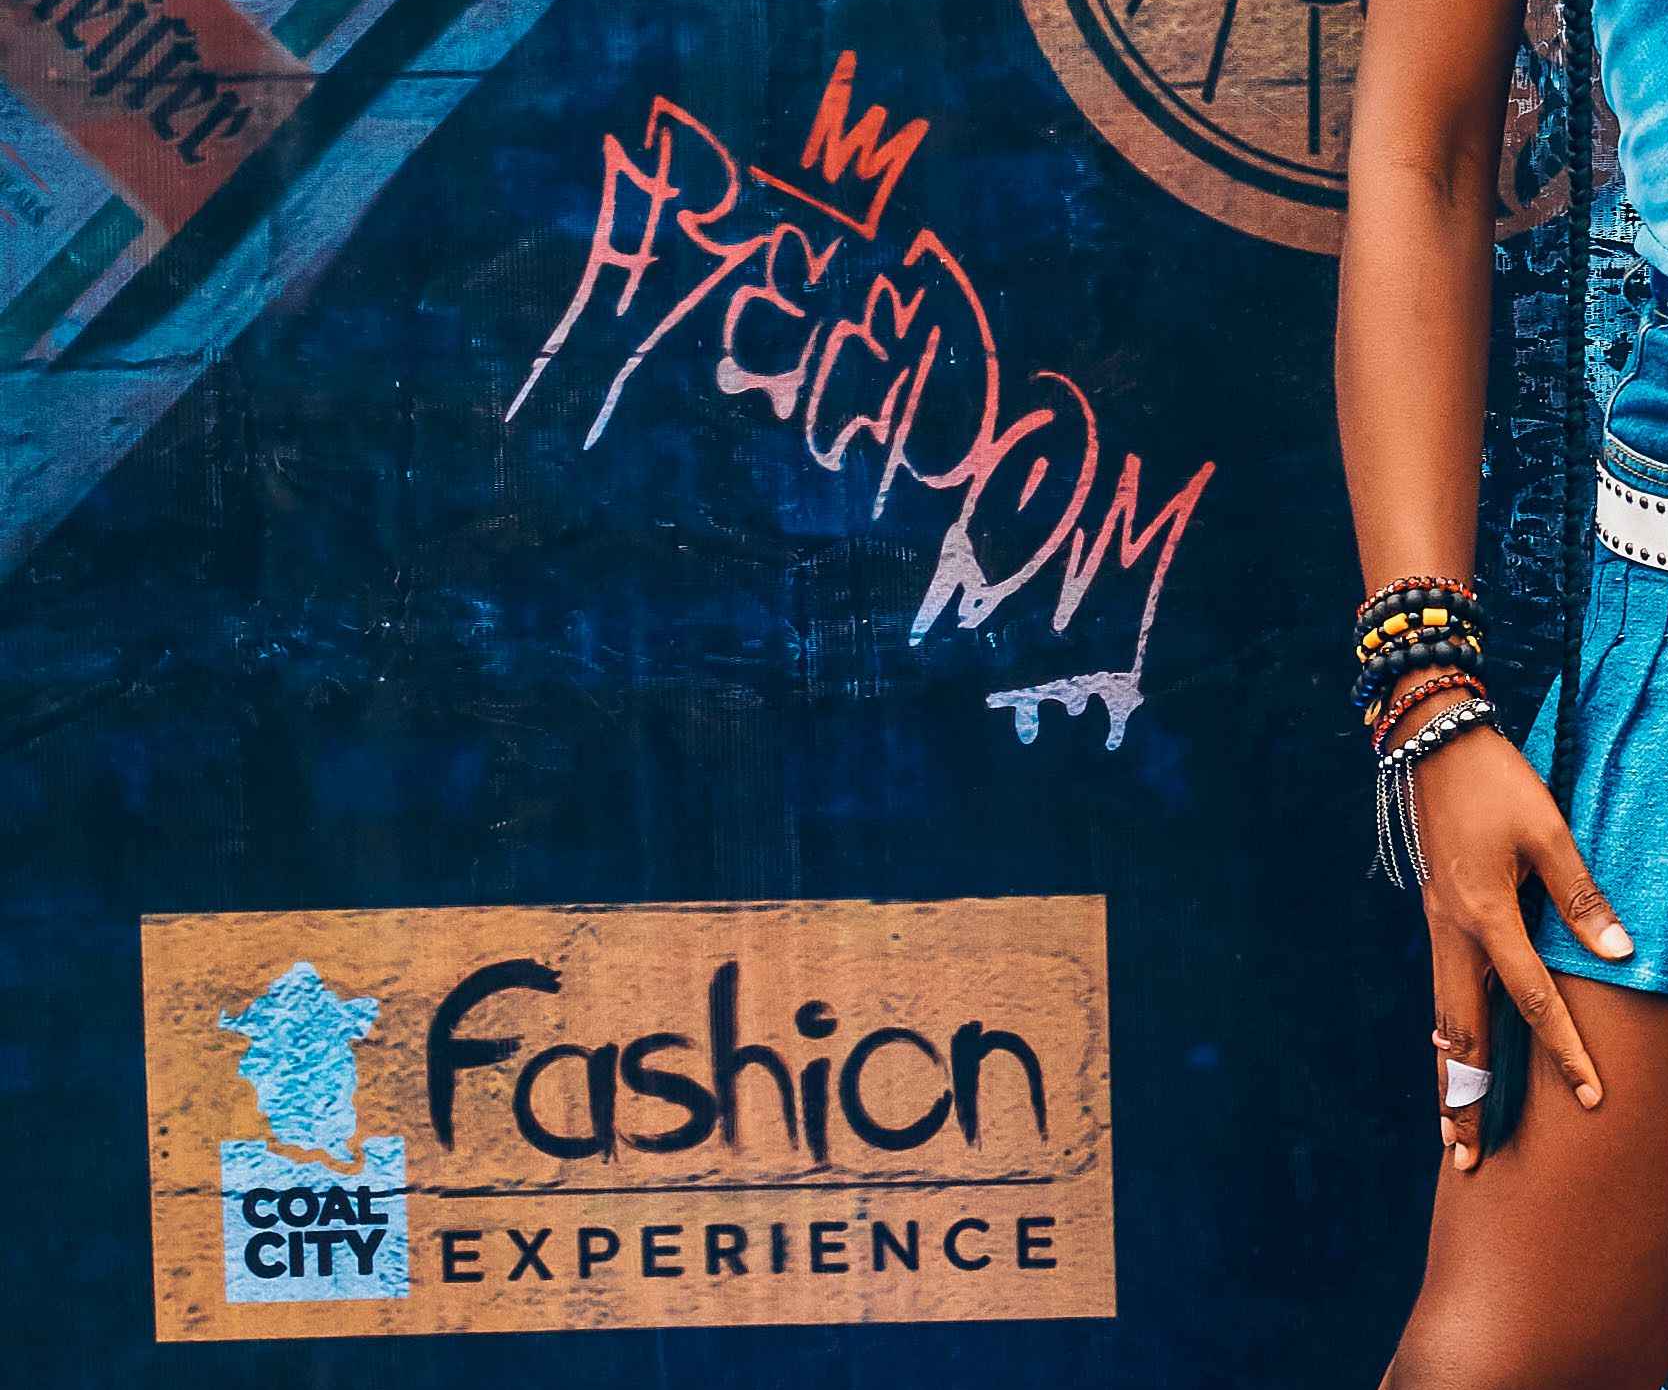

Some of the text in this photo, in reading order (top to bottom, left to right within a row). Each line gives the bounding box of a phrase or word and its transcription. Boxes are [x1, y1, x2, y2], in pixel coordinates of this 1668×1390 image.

[426, 958, 1049, 1171] Fashion
[241, 1186, 389, 1228] COAL
[242, 1228, 387, 1280] CITY
[441, 1216, 1059, 1285] EXPERIENCE
